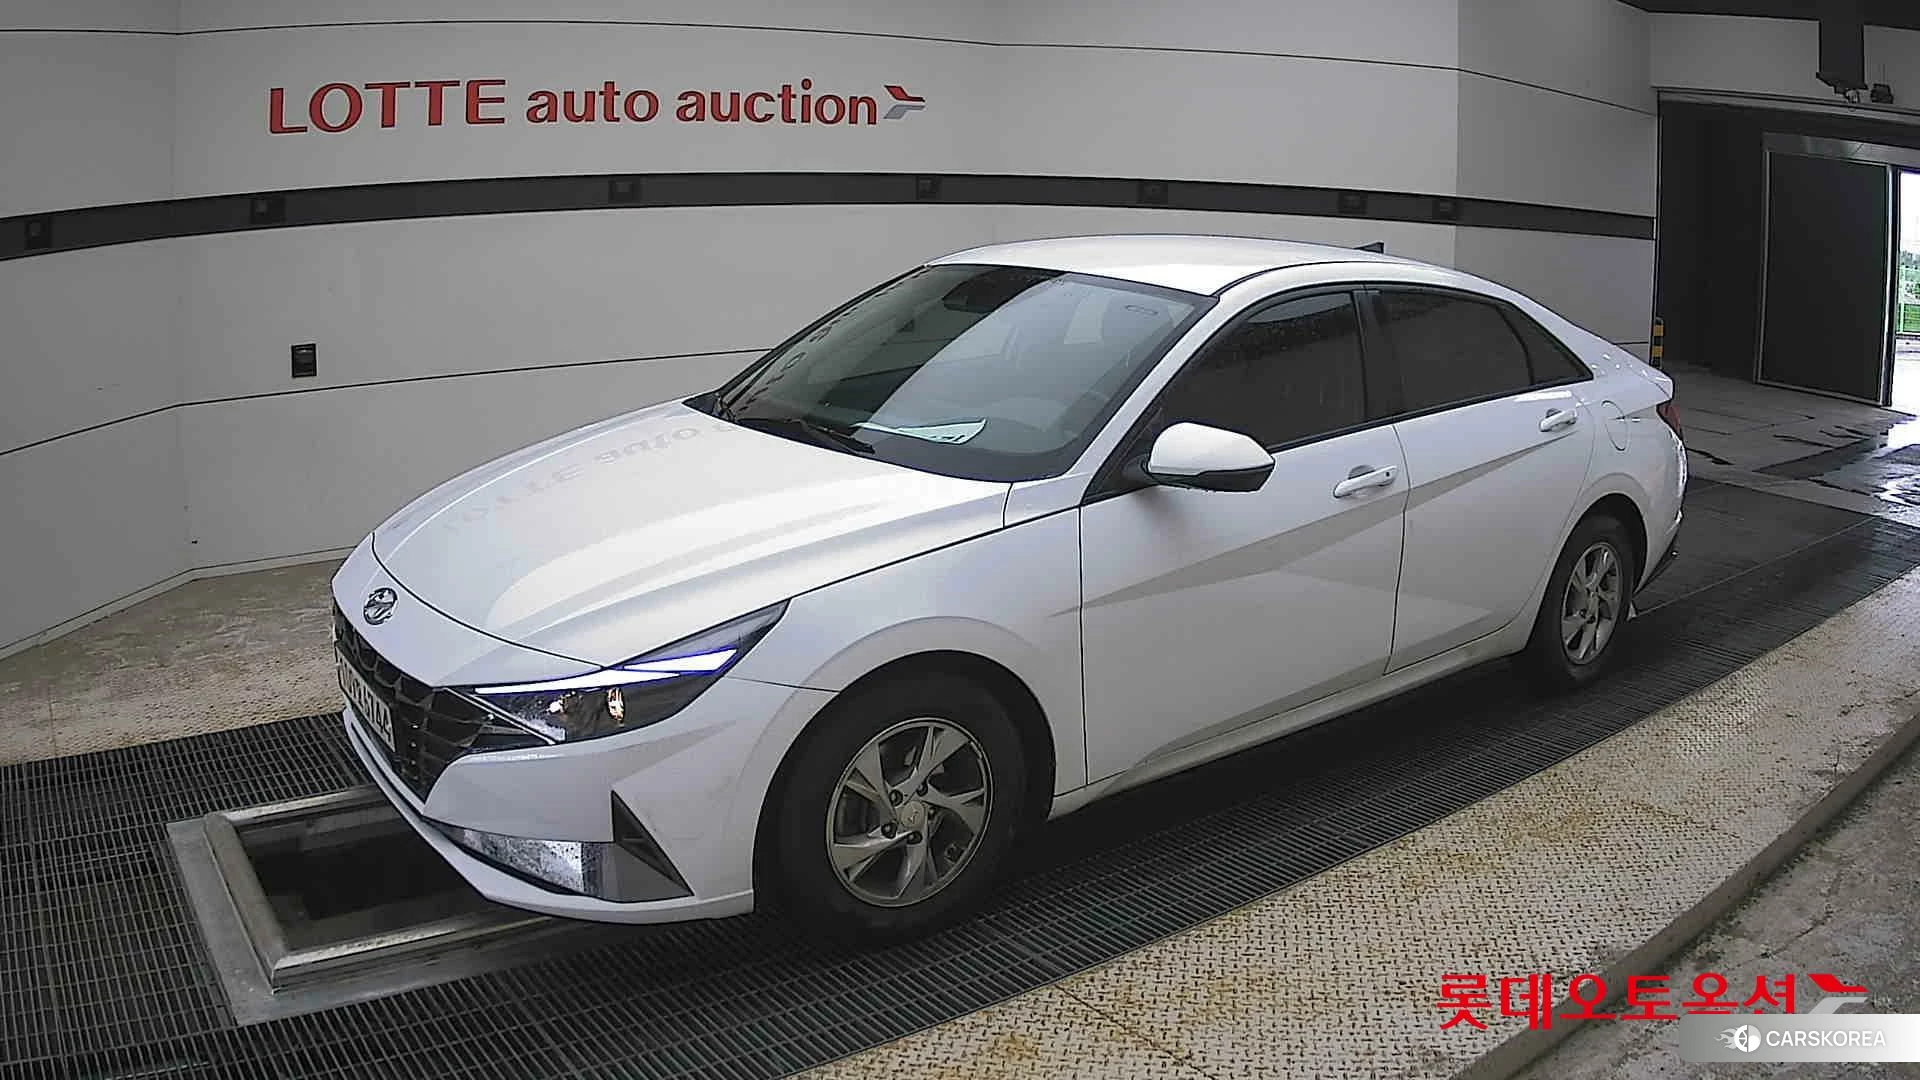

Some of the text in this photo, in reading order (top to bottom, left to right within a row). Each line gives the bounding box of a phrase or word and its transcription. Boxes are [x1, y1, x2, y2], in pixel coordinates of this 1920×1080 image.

[269, 78, 879, 134] LOTTE auto auction
